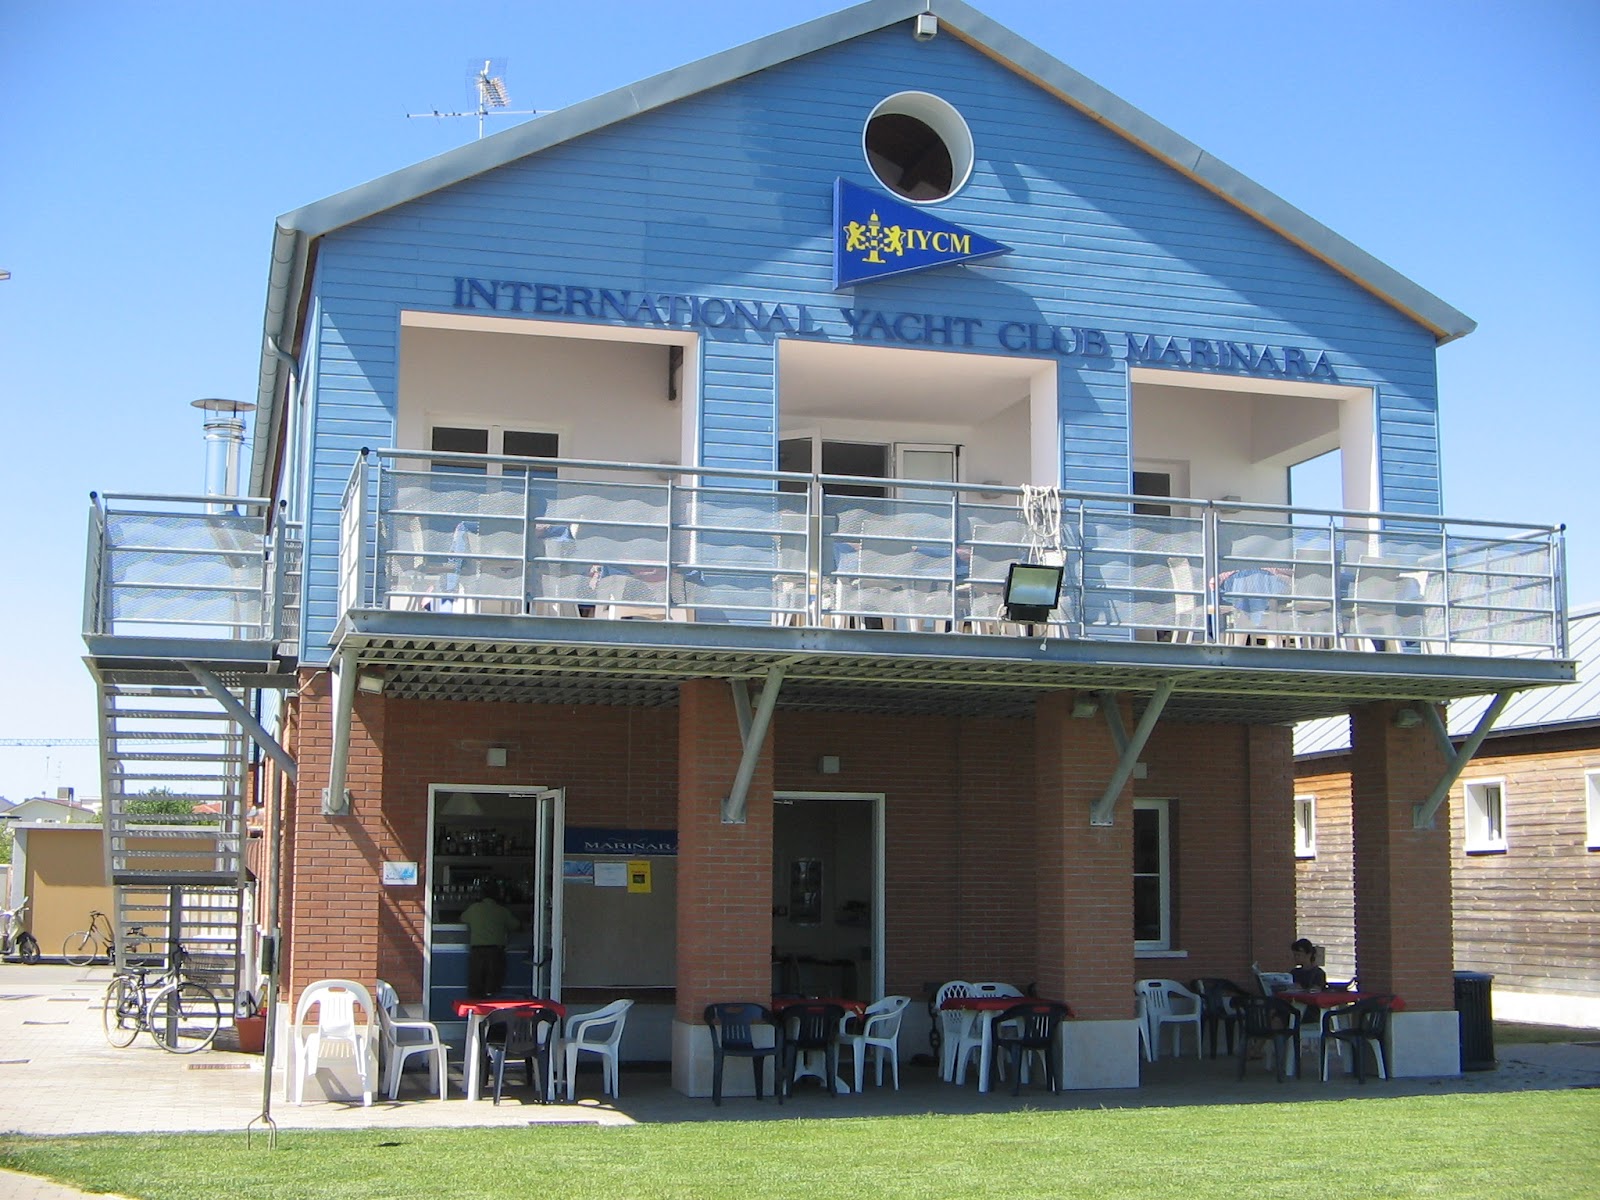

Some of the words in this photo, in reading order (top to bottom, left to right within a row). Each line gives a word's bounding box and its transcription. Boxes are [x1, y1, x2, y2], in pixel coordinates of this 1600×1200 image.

[906, 228, 972, 255] IYCM
[453, 276, 824, 336] INTERNATIONAL
[839, 307, 983, 347] YACHT
[998, 321, 1105, 358] CLUB
[1124, 331, 1333, 377] MARINARA
